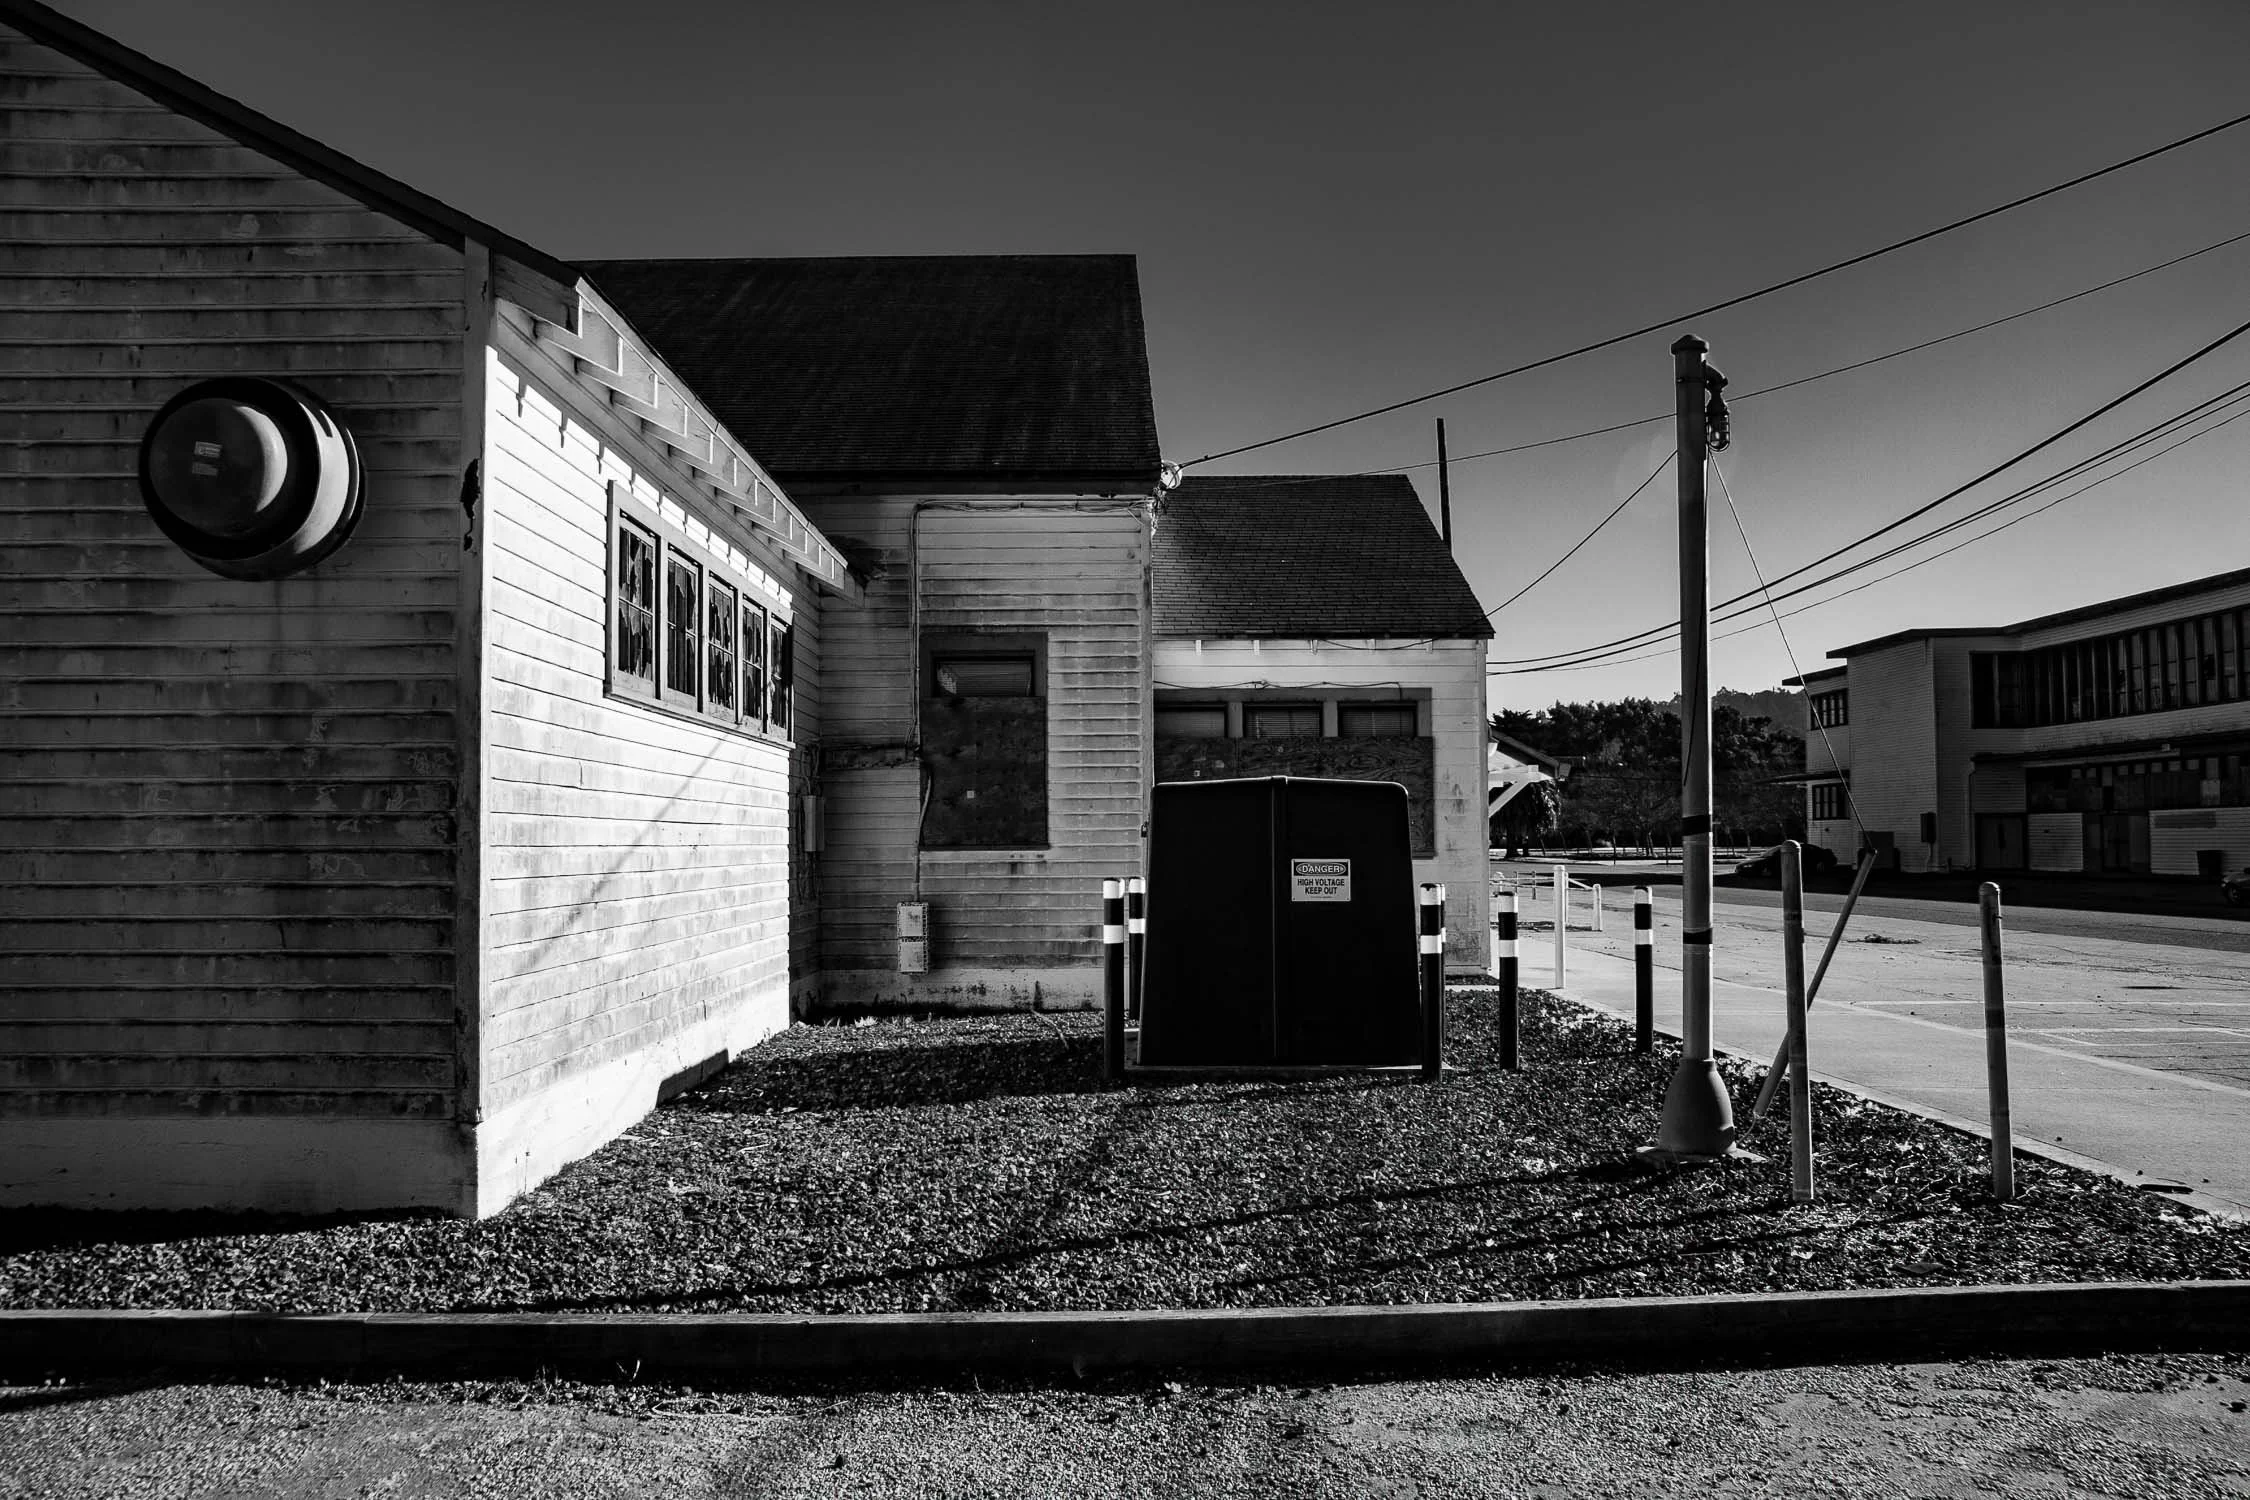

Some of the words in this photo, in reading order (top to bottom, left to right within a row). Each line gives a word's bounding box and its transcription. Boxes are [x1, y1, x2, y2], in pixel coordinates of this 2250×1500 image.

[1302, 865, 1340, 873] DANGER
[1297, 878, 1314, 886] HIGH
[1315, 878, 1345, 886] VOLTAGE
